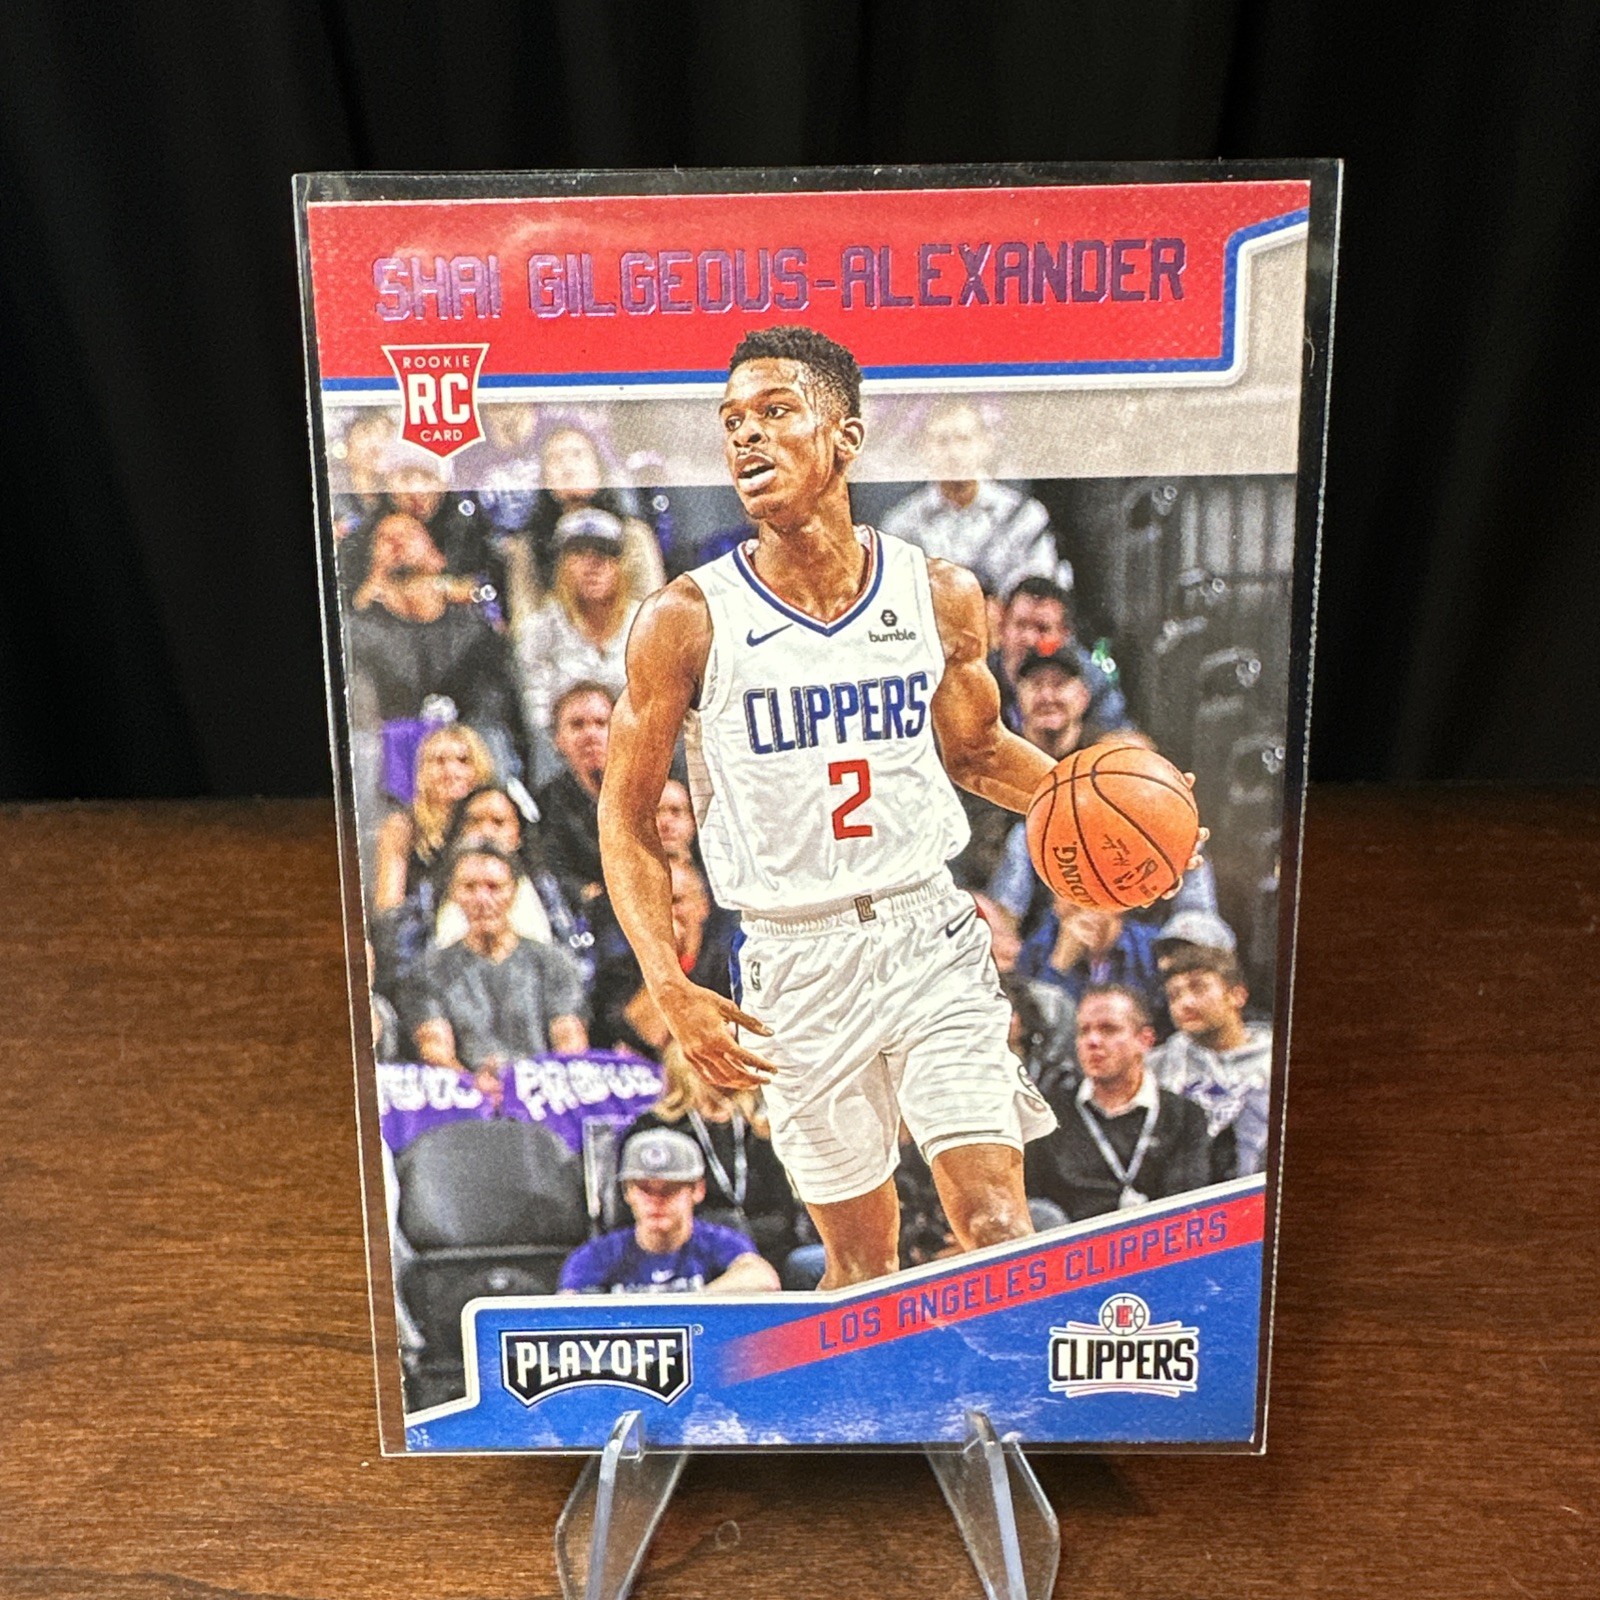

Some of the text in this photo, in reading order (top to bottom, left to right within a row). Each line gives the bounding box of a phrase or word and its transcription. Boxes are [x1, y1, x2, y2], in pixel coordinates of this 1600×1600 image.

[372, 238, 1187, 321] SHAI GILGEOUS-ALEXANDER
[402, 355, 471, 369] ROOKIE
[407, 372, 471, 425] RC
[420, 429, 463, 442] CARD
[868, 628, 917, 643] bumble
[743, 671, 928, 755] CLIPPERS
[828, 758, 873, 840] 2
[819, 1210, 1229, 1351] LOS ANGELES CLIPPERS
[515, 1338, 678, 1388] PLAYOFF
[1051, 1336, 1195, 1382] CLIPPERS
